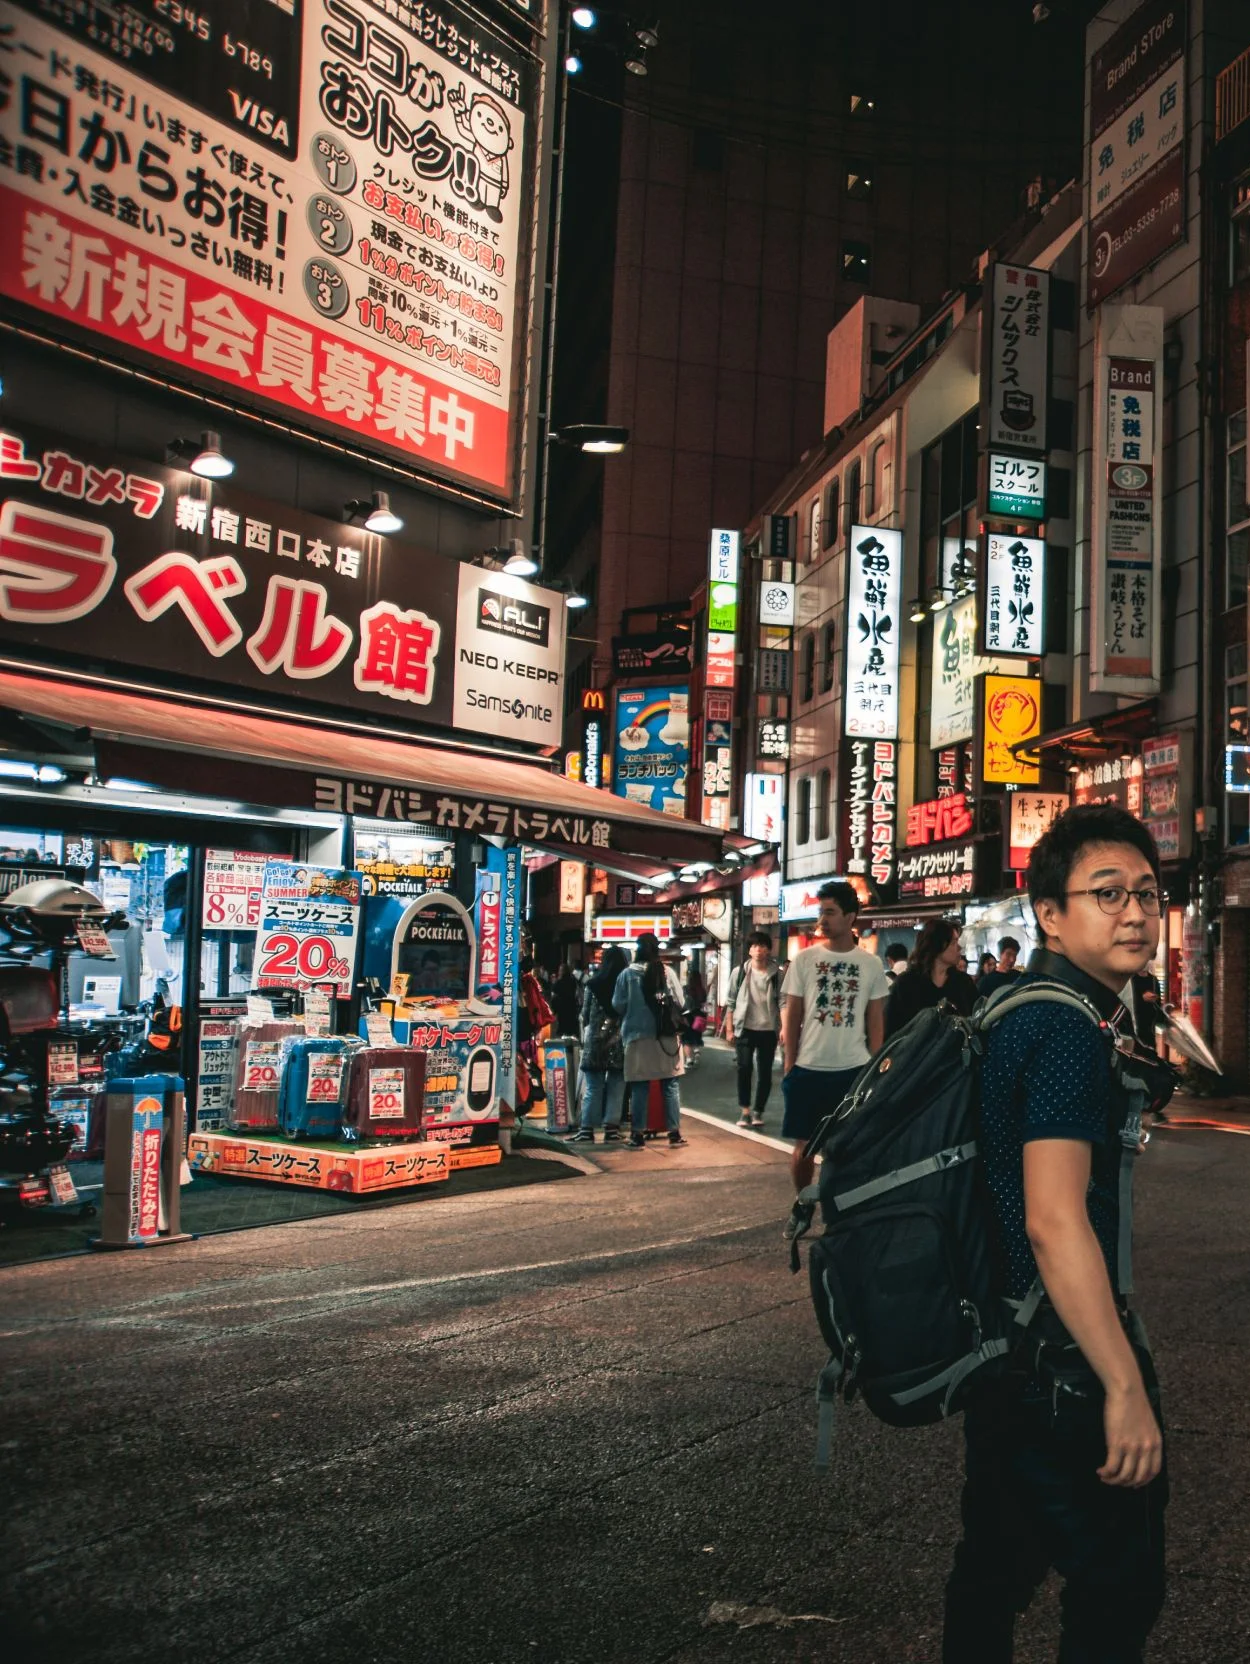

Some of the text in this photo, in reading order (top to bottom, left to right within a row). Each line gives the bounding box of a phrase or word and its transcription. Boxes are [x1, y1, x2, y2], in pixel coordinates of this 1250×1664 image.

[221, 32, 273, 79] 6789
[321, 0, 445, 112] ココが
[1106, 45, 1138, 92] Brand
[228, 88, 291, 147] VISA
[1098, 81, 1178, 176] 免税店
[318, 138, 350, 165] おトク
[326, 160, 337, 187] 1
[316, 198, 345, 222] おトク
[372, 161, 501, 247] クレジット機能付きで
[320, 219, 337, 248] 2
[362, 179, 505, 277] お支払いがお得!
[310, 263, 343, 288] おトク
[370, 219, 499, 302] 現金でお支払いより
[317, 283, 334, 310] 3
[1024, 289, 1042, 337] 株式会社
[17, 207, 475, 462] 新規会員募集中
[1000, 295, 1023, 387] シムックス
[1110, 367, 1152, 385] Brand
[998, 430, 1037, 445] 新宿営業所
[1121, 395, 1142, 461] 免税店
[994, 460, 1041, 480] ゴルフ
[994, 478, 1039, 494] スクール
[1120, 470, 1142, 487] 3F
[991, 494, 1031, 504] ゴルフステーション
[1010, 504, 1023, 513] 4F
[1114, 500, 1146, 512] UNITED
[1109, 510, 1151, 523] FASHIONS
[174, 494, 361, 580] 新宿西口本店
[719, 532, 731, 579] 桑原ビル
[0, 500, 441, 704] ラベル館
[1110, 573, 1127, 655] 讃岐うどん
[1130, 573, 1147, 639] 本格そば
[459, 648, 559, 686] NEO KEEPR
[708, 656, 732, 667] アコム
[714, 674, 726, 684] 3F
[466, 688, 553, 723] Samsonite
[618, 763, 677, 779] ランチパック
[704, 761, 718, 794] カメラ
[717, 748, 730, 792] ヨドバシ
[314, 777, 612, 849] ヨドバシカメラトラベル館
[847, 741, 869, 873] ケータイアクセサリー館
[871, 741, 894, 884] ヨドバシカメラ
[906, 793, 973, 847] ヨドバシ
[897, 846, 974, 880] ケータイアクセサリー館
[267, 887, 308, 898] SUMMER
[378, 880, 423, 893] POCKETALK
[923, 873, 973, 898] ヨドバシカメラ
[207, 894, 244, 924] 8%
[265, 905, 354, 924] スーツケース
[411, 926, 463, 941] POCKETALK
[481, 909, 497, 976] トラベル館
[259, 932, 351, 980] 20%
[411, 1024, 501, 1048] ポケトーク W
[247, 1148, 321, 1174] スーツケース
[385, 1153, 446, 1176] スーツケース
[142, 1133, 160, 1231] 折りたたみ傘
